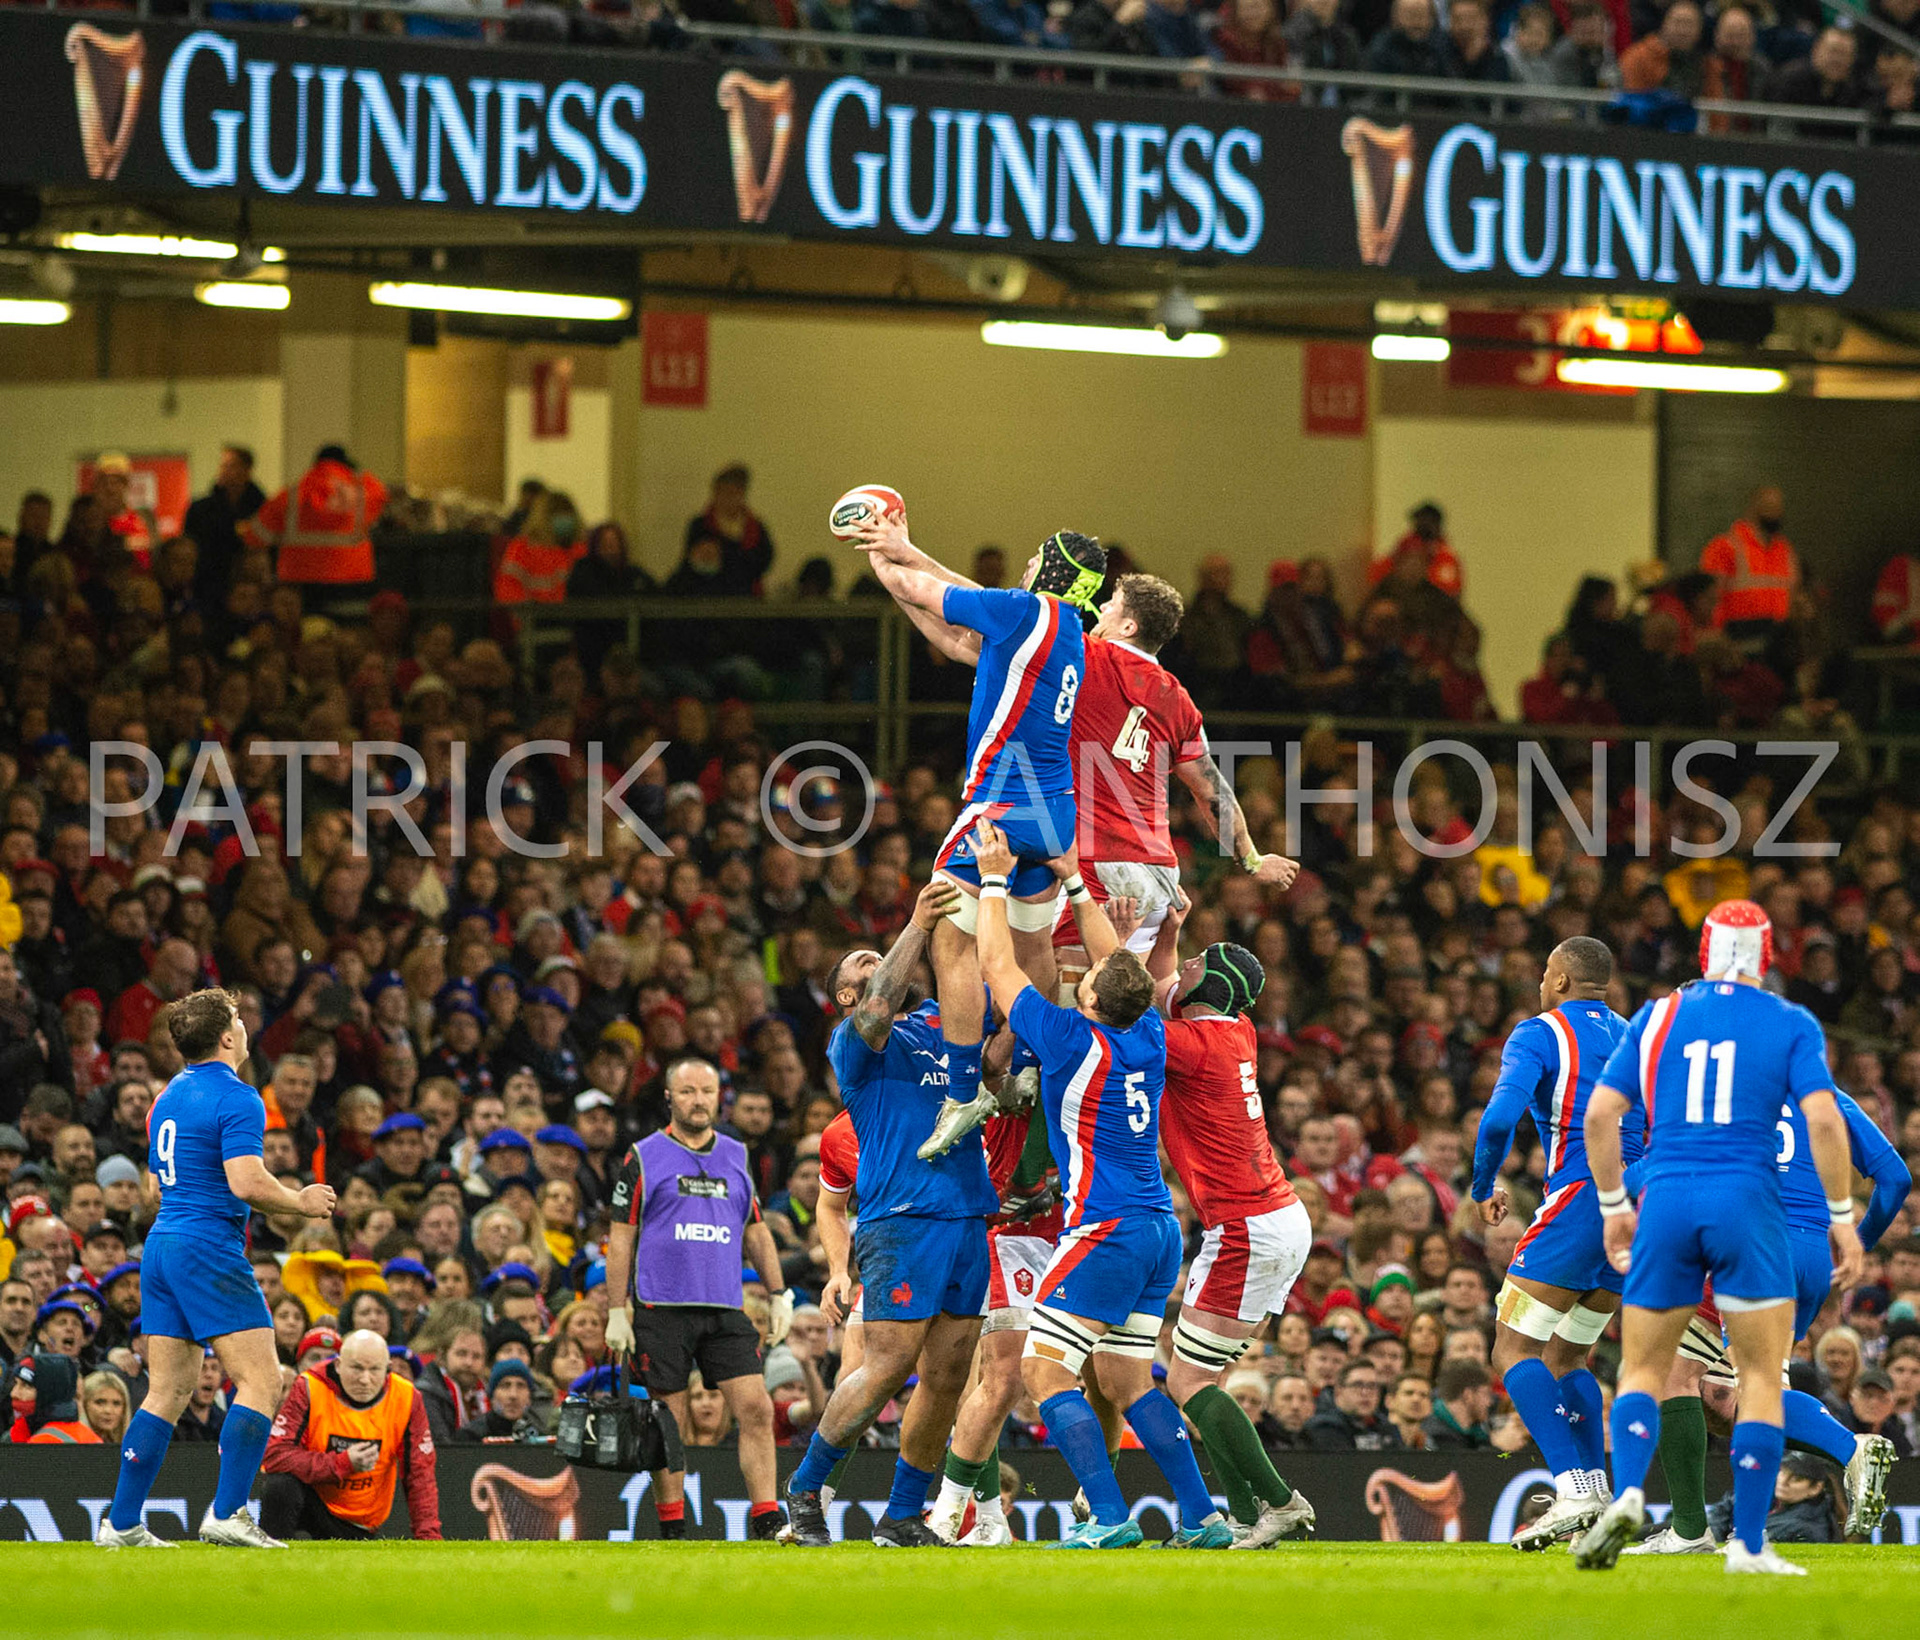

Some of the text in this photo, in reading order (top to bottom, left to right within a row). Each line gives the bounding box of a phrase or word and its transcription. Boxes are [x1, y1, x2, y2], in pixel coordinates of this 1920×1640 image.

[160, 30, 647, 214] GUINNESS
[805, 76, 1265, 256] GUINNESS
[1424, 123, 1857, 296] GUINNESS
[1054, 664, 1079, 724] 8
[1111, 706, 1150, 773] 4
[919, 1071, 951, 1087] ALTR
[1123, 1071, 1151, 1133] 5
[1682, 1039, 1737, 1125] 11
[156, 1118, 177, 1187] 9
[674, 1223, 731, 1244] MEDIC
